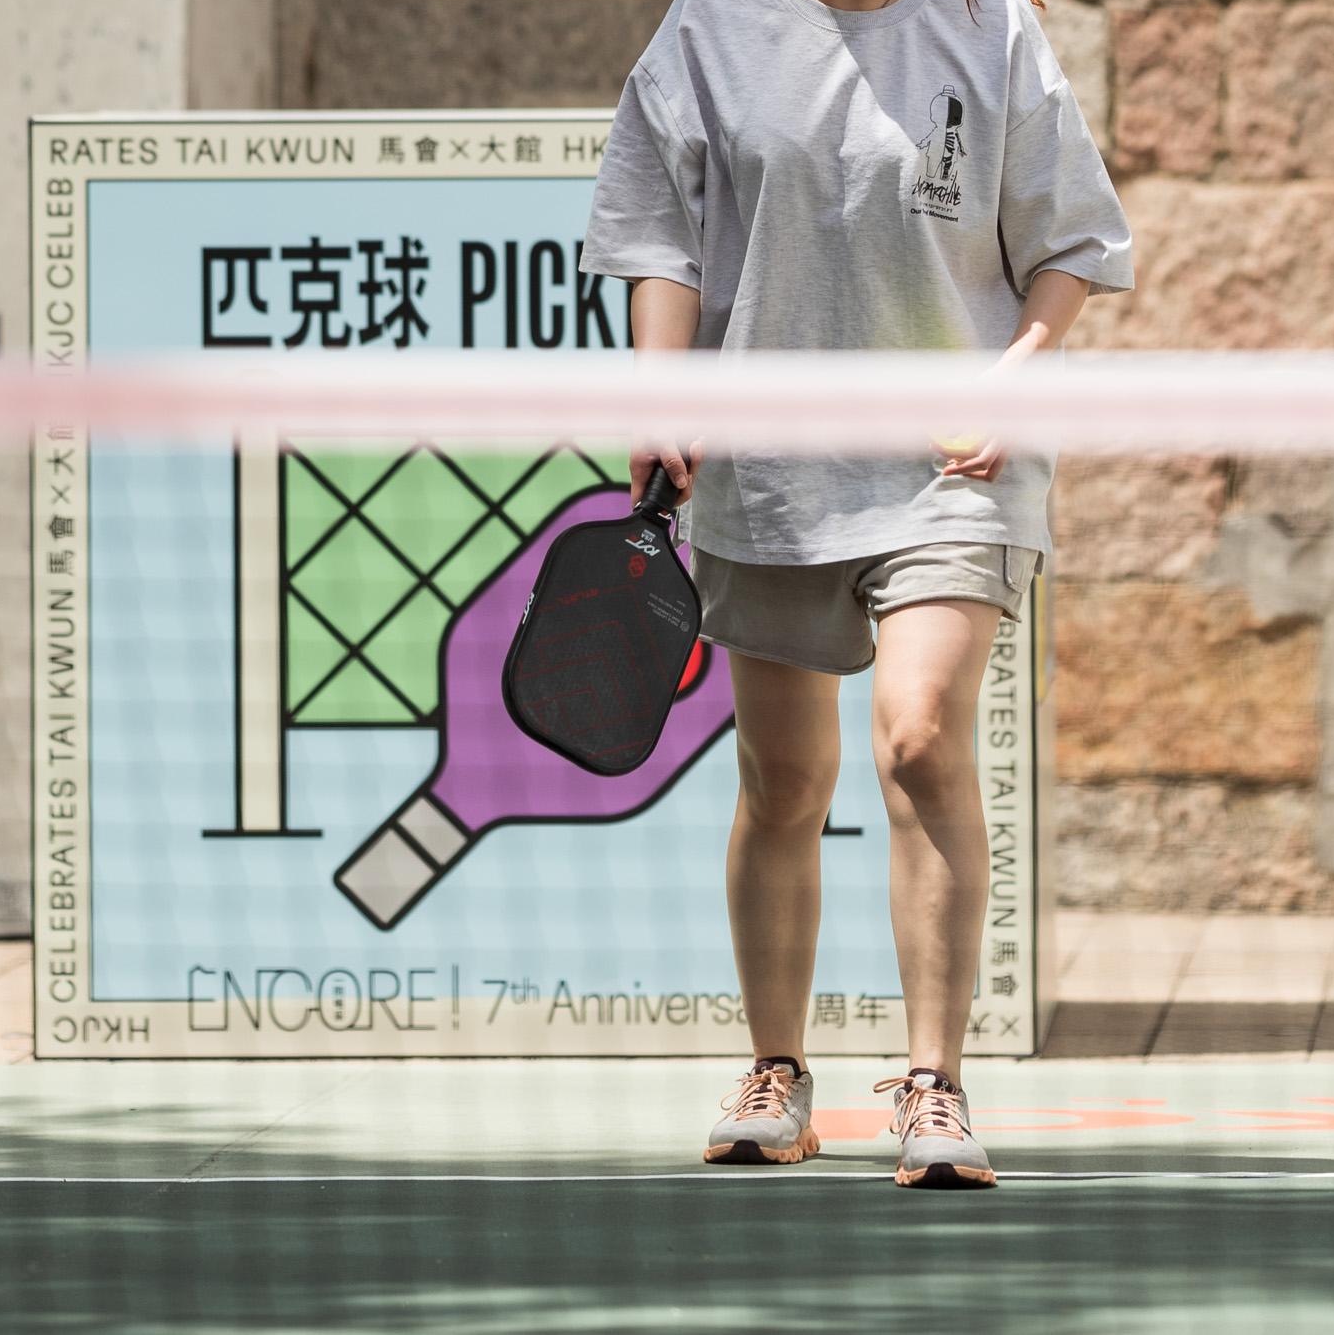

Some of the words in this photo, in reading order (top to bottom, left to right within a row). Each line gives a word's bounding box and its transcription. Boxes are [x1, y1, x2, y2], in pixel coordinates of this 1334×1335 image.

[51, 138, 157, 164] RATES
[176, 138, 226, 163] TAI
[247, 138, 353, 164] KWUN
[563, 137, 609, 164] HK
[201, 235, 430, 350] 匹克球
[47, 301, 74, 376] KJC
[48, 590, 74, 698] KWUN
[49, 714, 75, 765] TAI
[991, 761, 1016, 810] TAI
[49, 779, 76, 1003] CELEBRATES
[991, 822, 1017, 928] KWUN
[54, 1016, 149, 1043] HKJC
[537, 978, 749, 1026] Anniversa
[810, 992, 891, 1030] 周年
